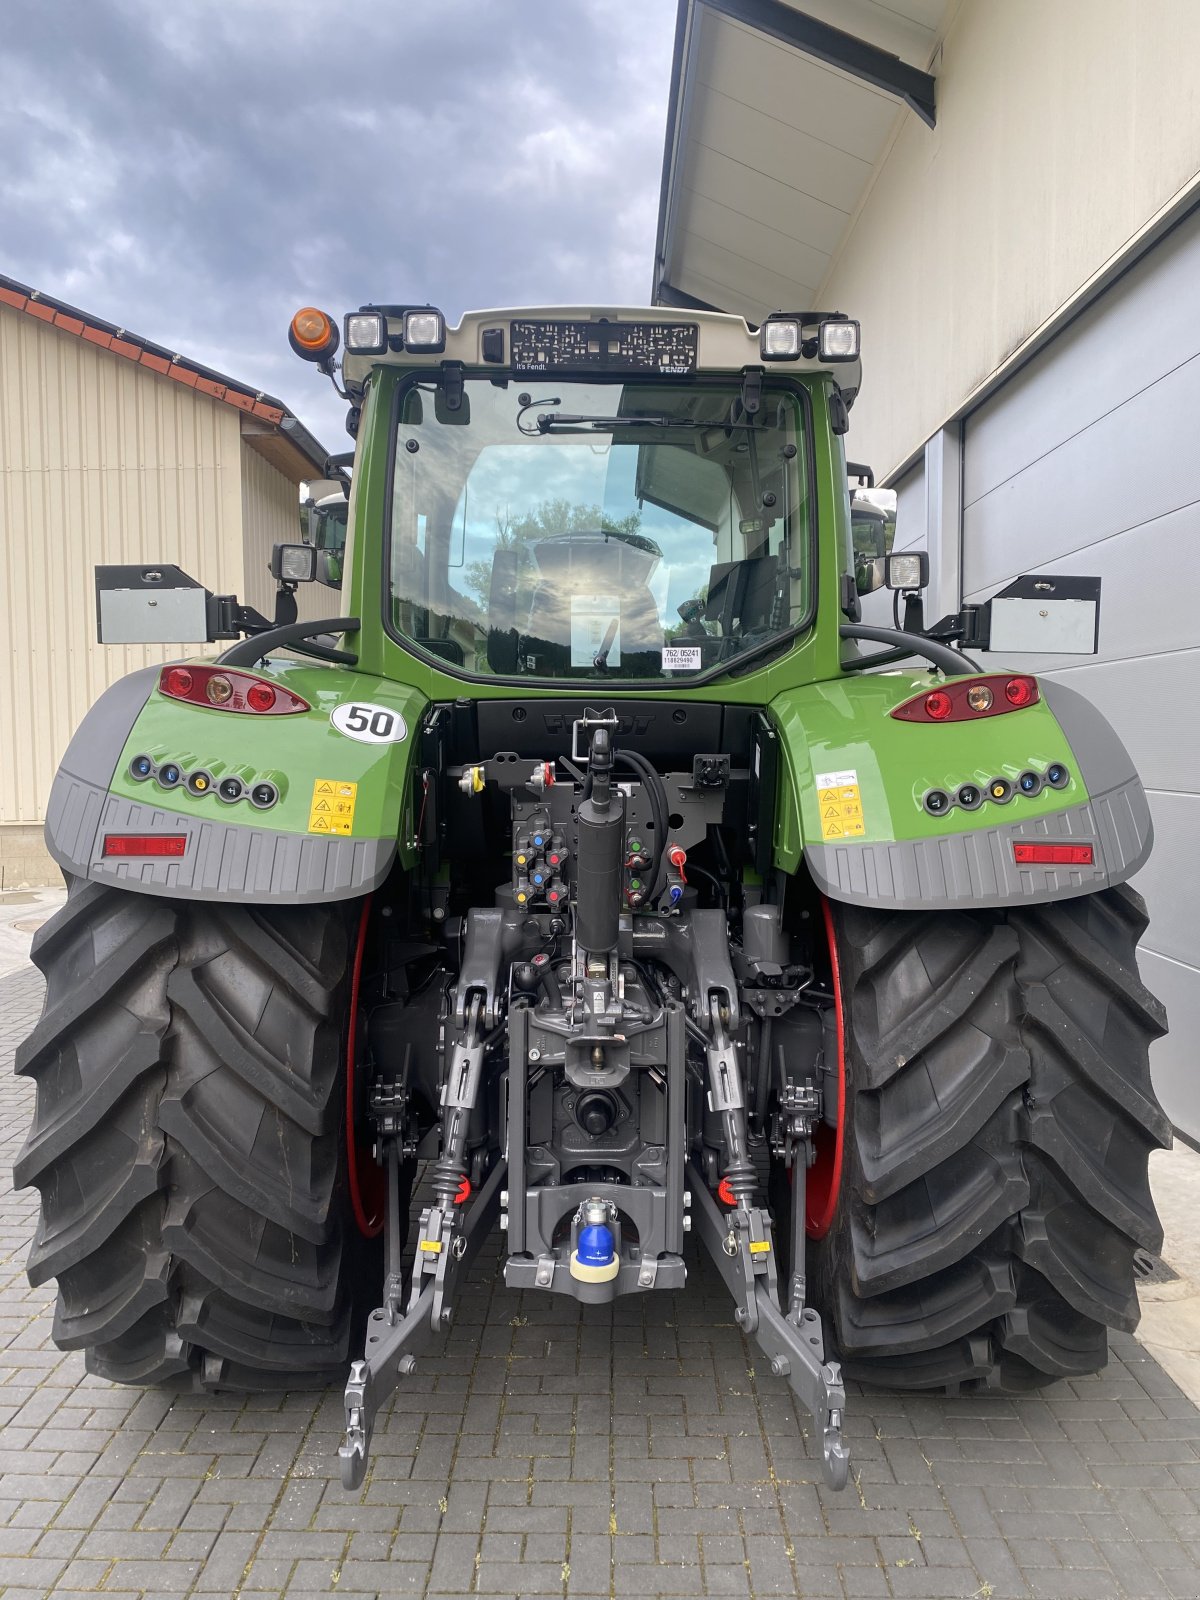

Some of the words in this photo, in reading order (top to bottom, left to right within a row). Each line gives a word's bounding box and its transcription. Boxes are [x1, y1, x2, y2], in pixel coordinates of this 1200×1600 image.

[516, 362, 526, 370] It's
[527, 362, 547, 370] Fendt.
[660, 366, 690, 374] FENDT
[345, 705, 395, 737] 50
